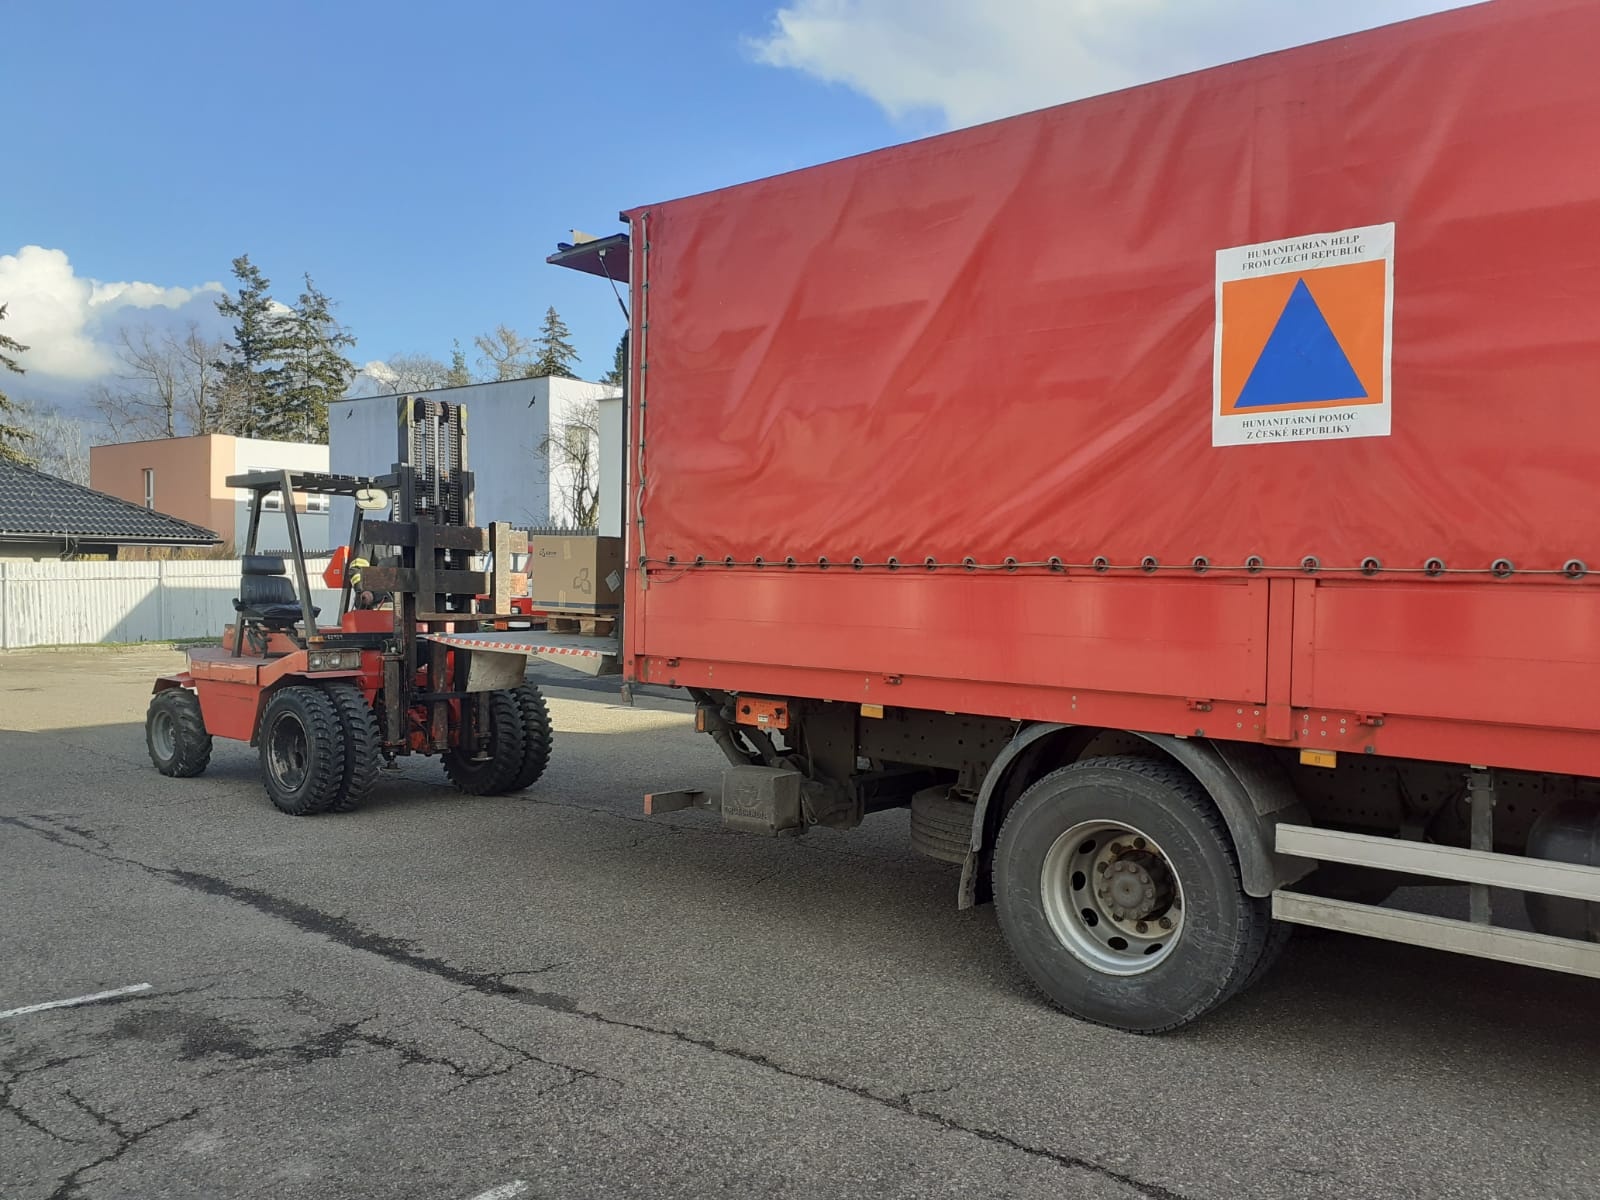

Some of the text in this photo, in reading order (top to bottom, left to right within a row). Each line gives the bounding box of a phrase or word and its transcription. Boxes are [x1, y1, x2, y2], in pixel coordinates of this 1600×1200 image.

[1247, 234, 1360, 259] HUMANITARIAN HELP
[1242, 246, 1365, 270] FROM CZECH REPUBLIC
[1242, 412, 1359, 428] HUMANITÁRNÍ POMOC
[1247, 425, 1351, 439] Z ČESKÉ REPUBLIKY
